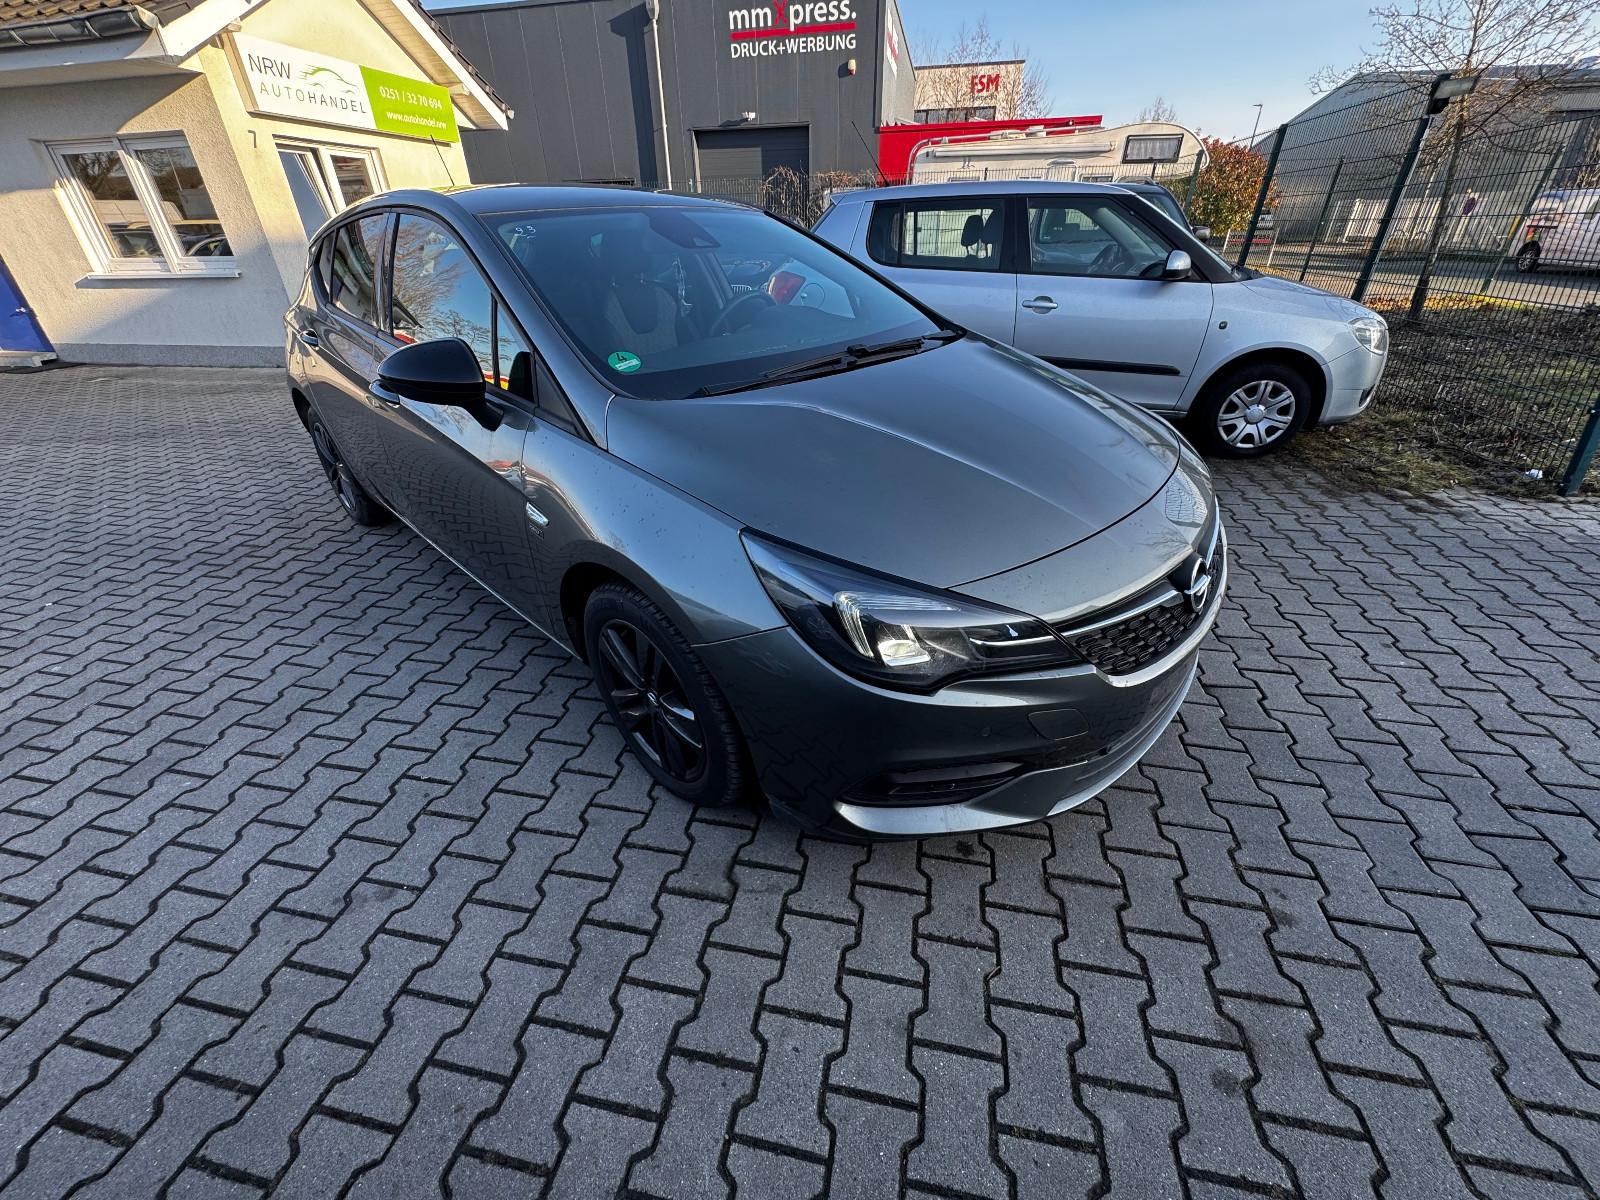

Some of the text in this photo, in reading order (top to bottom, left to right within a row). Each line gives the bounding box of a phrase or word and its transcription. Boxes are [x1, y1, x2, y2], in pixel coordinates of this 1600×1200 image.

[728, 0, 857, 31] mmXpress.
[730, 33, 857, 58] DRUCK+WERBUNG
[247, 53, 290, 79] NRW
[969, 73, 1001, 93] FSM
[259, 81, 367, 114] AUTOHANDEL
[379, 86, 400, 101] 0251
[406, 92, 417, 105] 32
[417, 95, 428, 107] 70
[428, 97, 443, 110] 694
[386, 111, 447, 129] www.autohandel.nrw
[616, 352, 628, 361] 4
